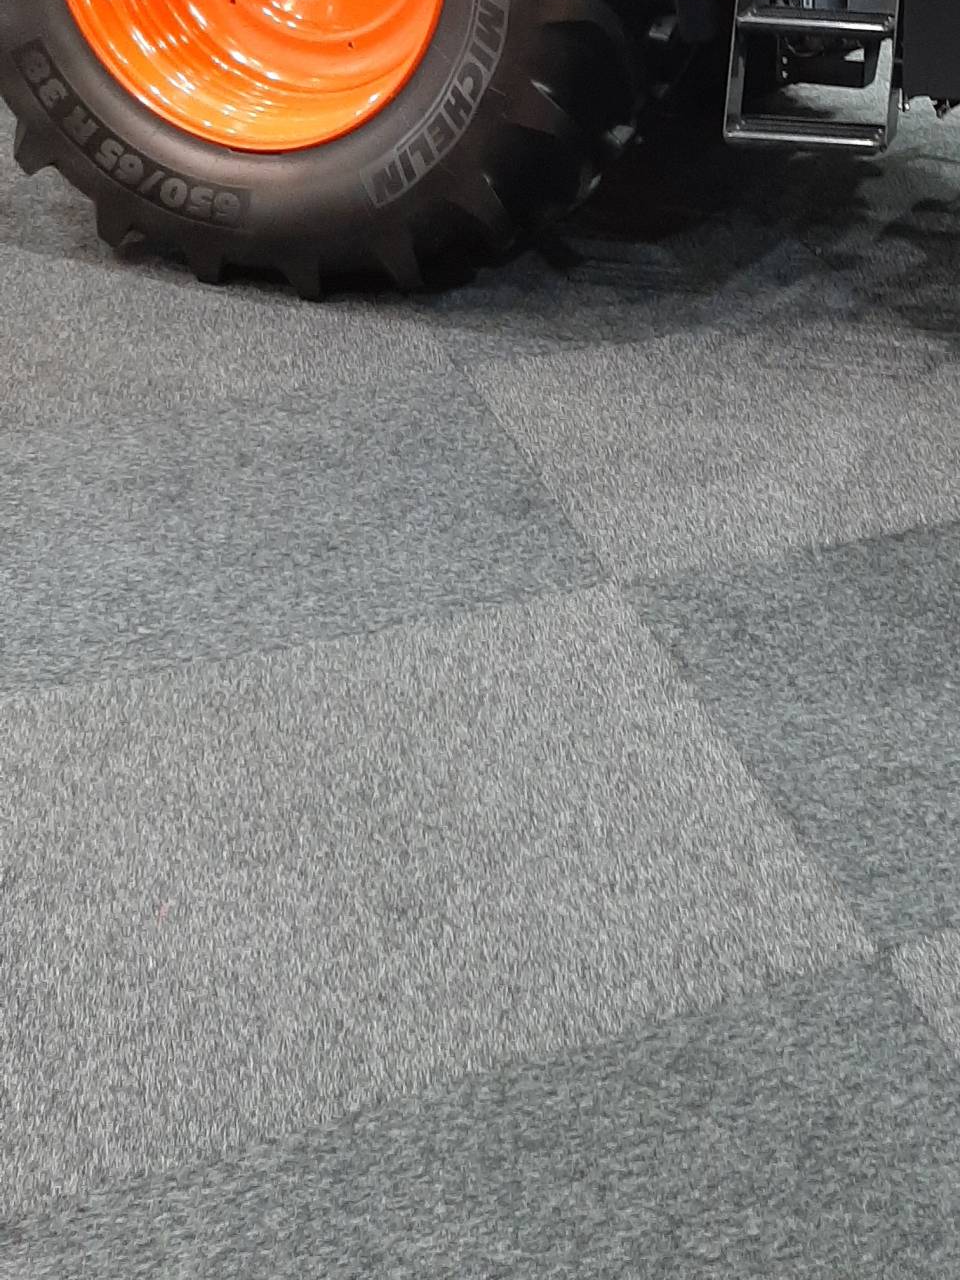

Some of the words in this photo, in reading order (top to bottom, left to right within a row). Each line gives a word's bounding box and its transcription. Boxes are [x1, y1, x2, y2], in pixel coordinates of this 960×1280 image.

[18, 48, 70, 109] 38
[62, 105, 100, 146] R
[95, 138, 242, 223] 650/65
